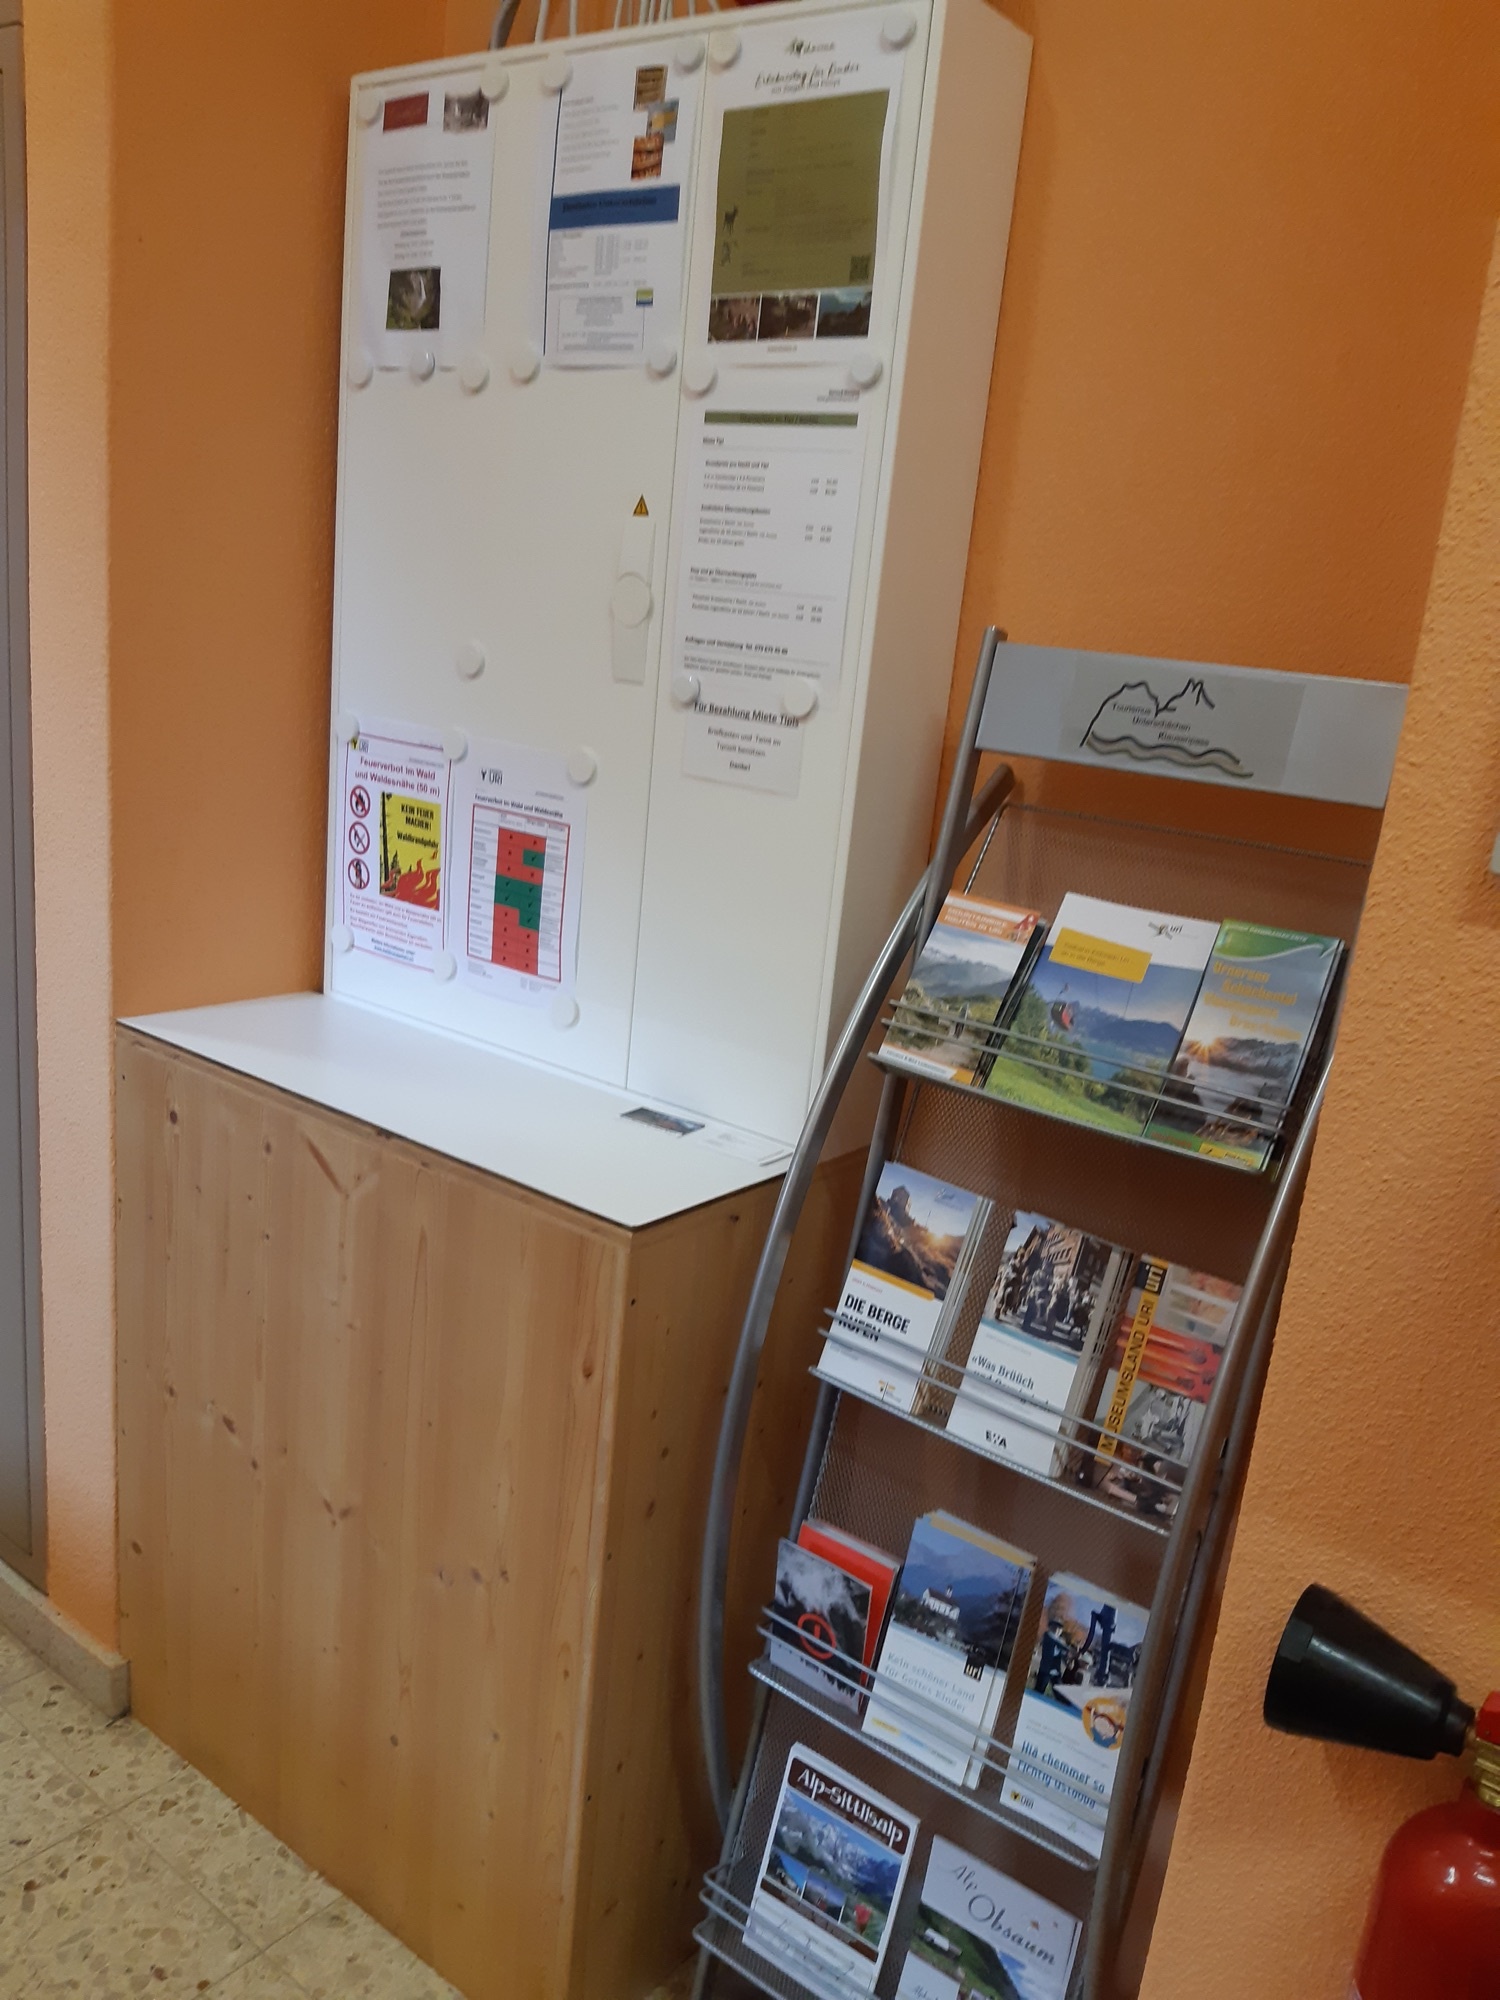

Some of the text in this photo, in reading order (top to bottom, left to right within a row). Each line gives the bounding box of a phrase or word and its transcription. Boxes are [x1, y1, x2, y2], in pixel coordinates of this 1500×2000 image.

[708, 703, 751, 721] Bezahlung
[752, 710, 777, 725] Miete
[360, 756, 404, 773] Feuerverbot
[405, 767, 415, 776] im
[416, 768, 436, 781] Wald
[355, 771, 440, 798] und Waldesnähe (50 m)
[1169, 923, 1184, 934] uri
[1144, 1264, 1164, 1293] uri
[838, 1311, 882, 1343] RUFEN
[844, 1292, 911, 1335] DIE BERGE
[1136, 1299, 1155, 1328] URI
[971, 1354, 997, 1373] «Was
[887, 1652, 976, 1701] Kein schöner Land
[965, 1663, 983, 1681] uri
[1041, 1752, 1092, 1786] chemmer
[1092, 1779, 1106, 1794] so
[952, 1865, 979, 1892] Alp
